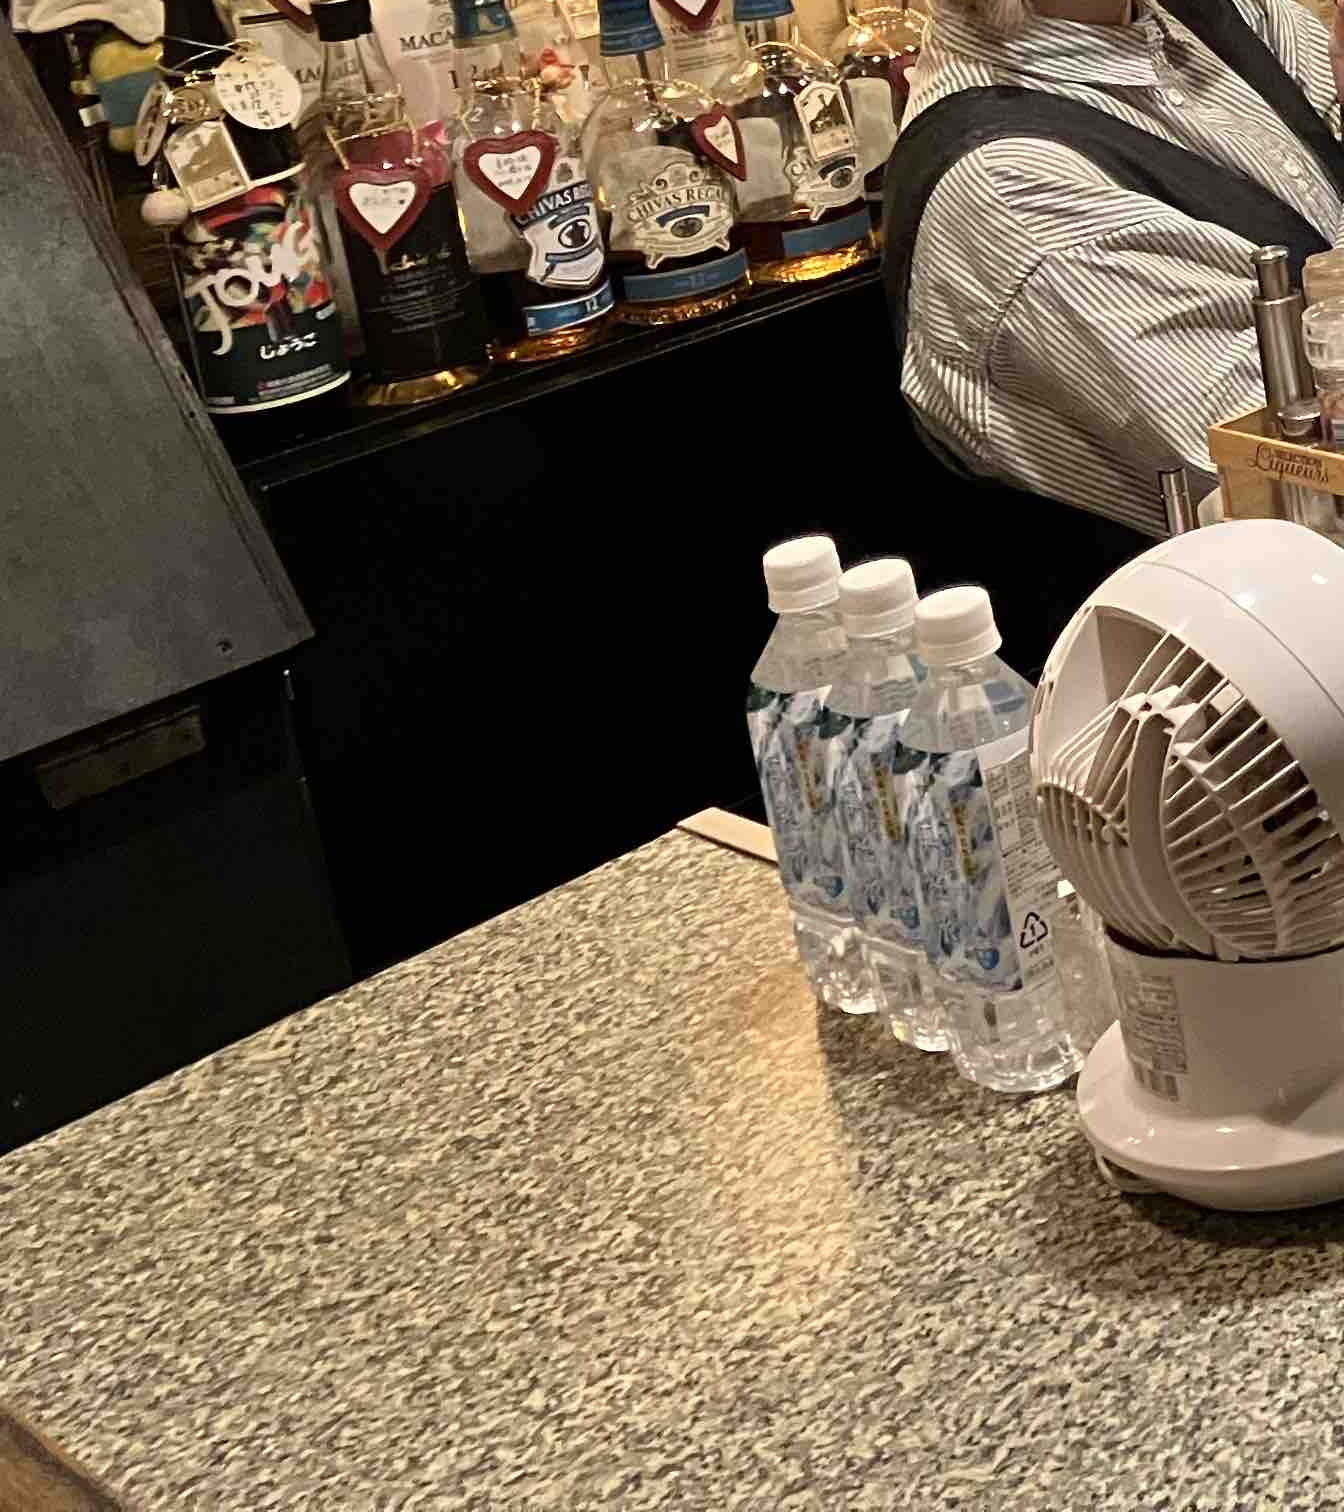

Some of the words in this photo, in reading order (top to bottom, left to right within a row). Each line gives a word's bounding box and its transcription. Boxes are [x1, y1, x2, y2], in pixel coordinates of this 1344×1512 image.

[627, 191, 681, 223] CHIVAS
[260, 332, 316, 360] じょうご
